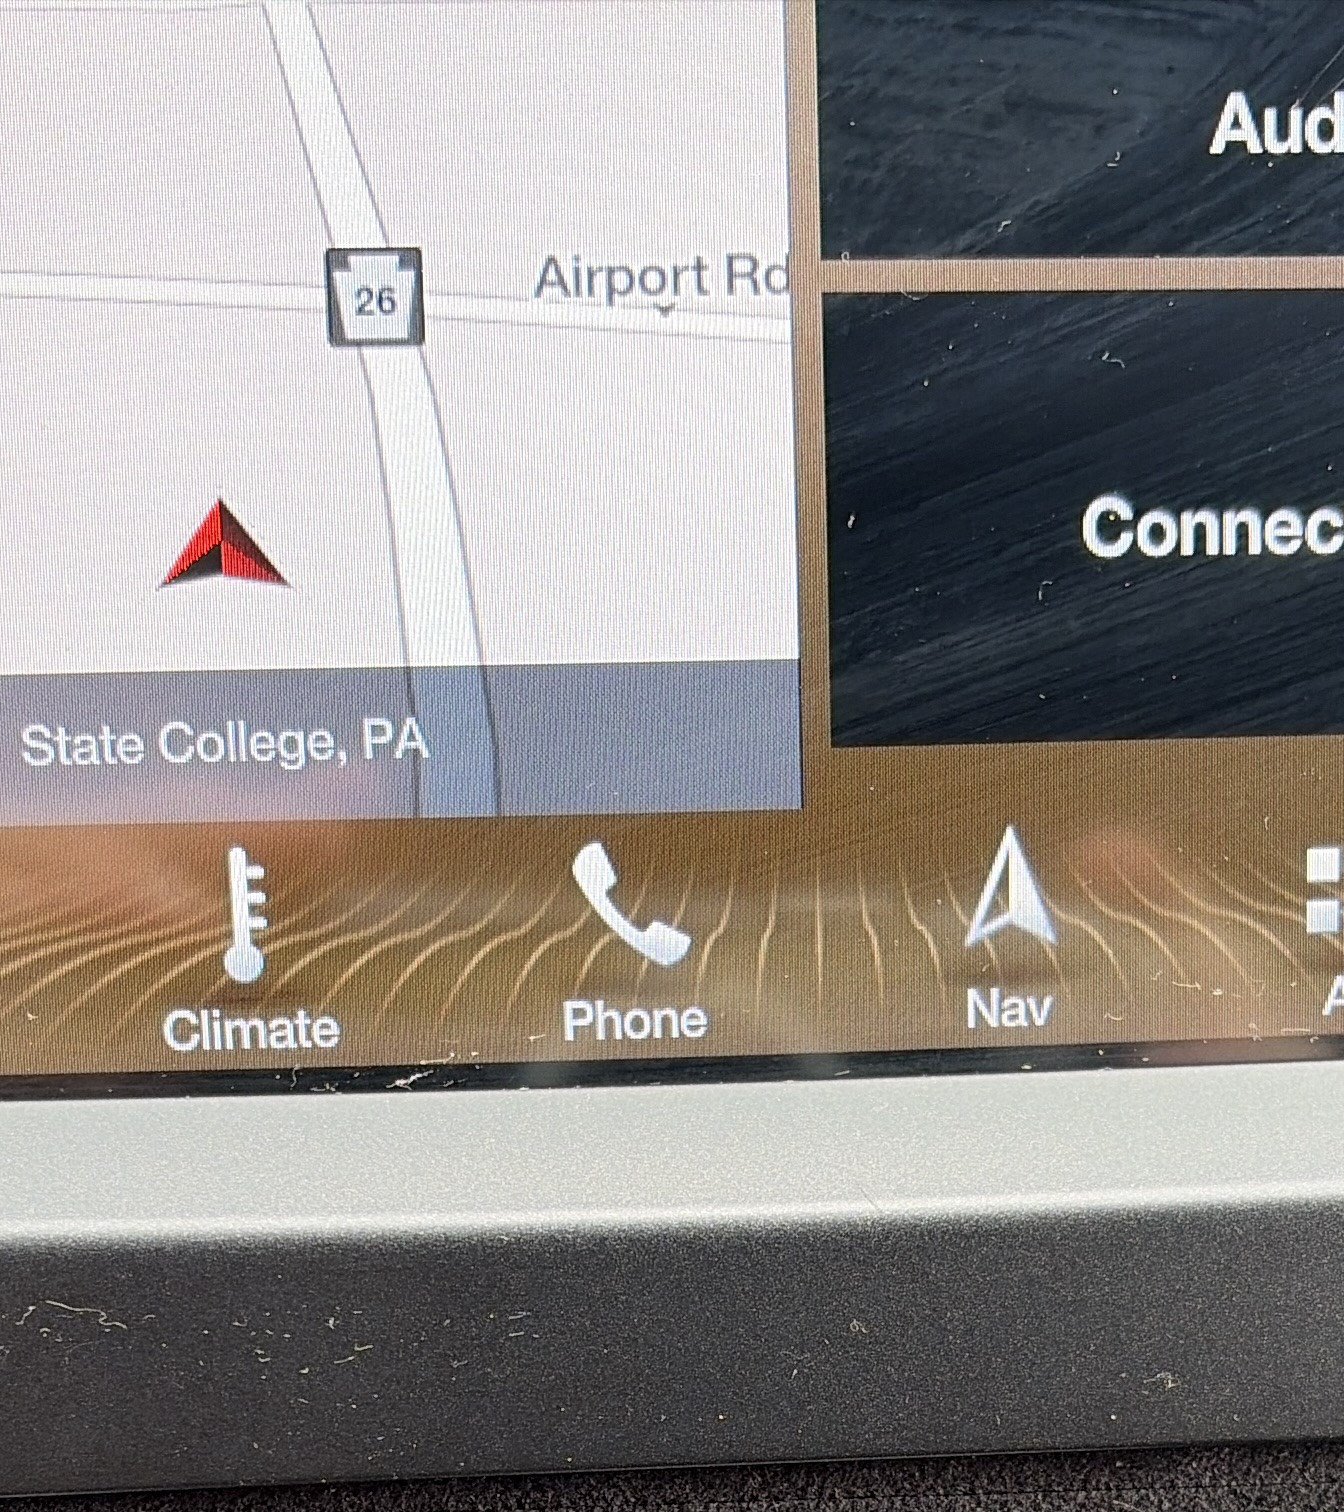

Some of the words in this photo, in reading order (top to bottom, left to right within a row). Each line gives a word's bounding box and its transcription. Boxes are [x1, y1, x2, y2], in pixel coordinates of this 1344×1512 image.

[354, 285, 398, 317] 26
[533, 254, 709, 305] Airport
[20, 720, 146, 768] State
[157, 718, 348, 772] College,
[362, 715, 431, 761] PA
[161, 1008, 341, 1053] Climate
[562, 998, 709, 1043] Phone
[966, 986, 1054, 1030] Nav
